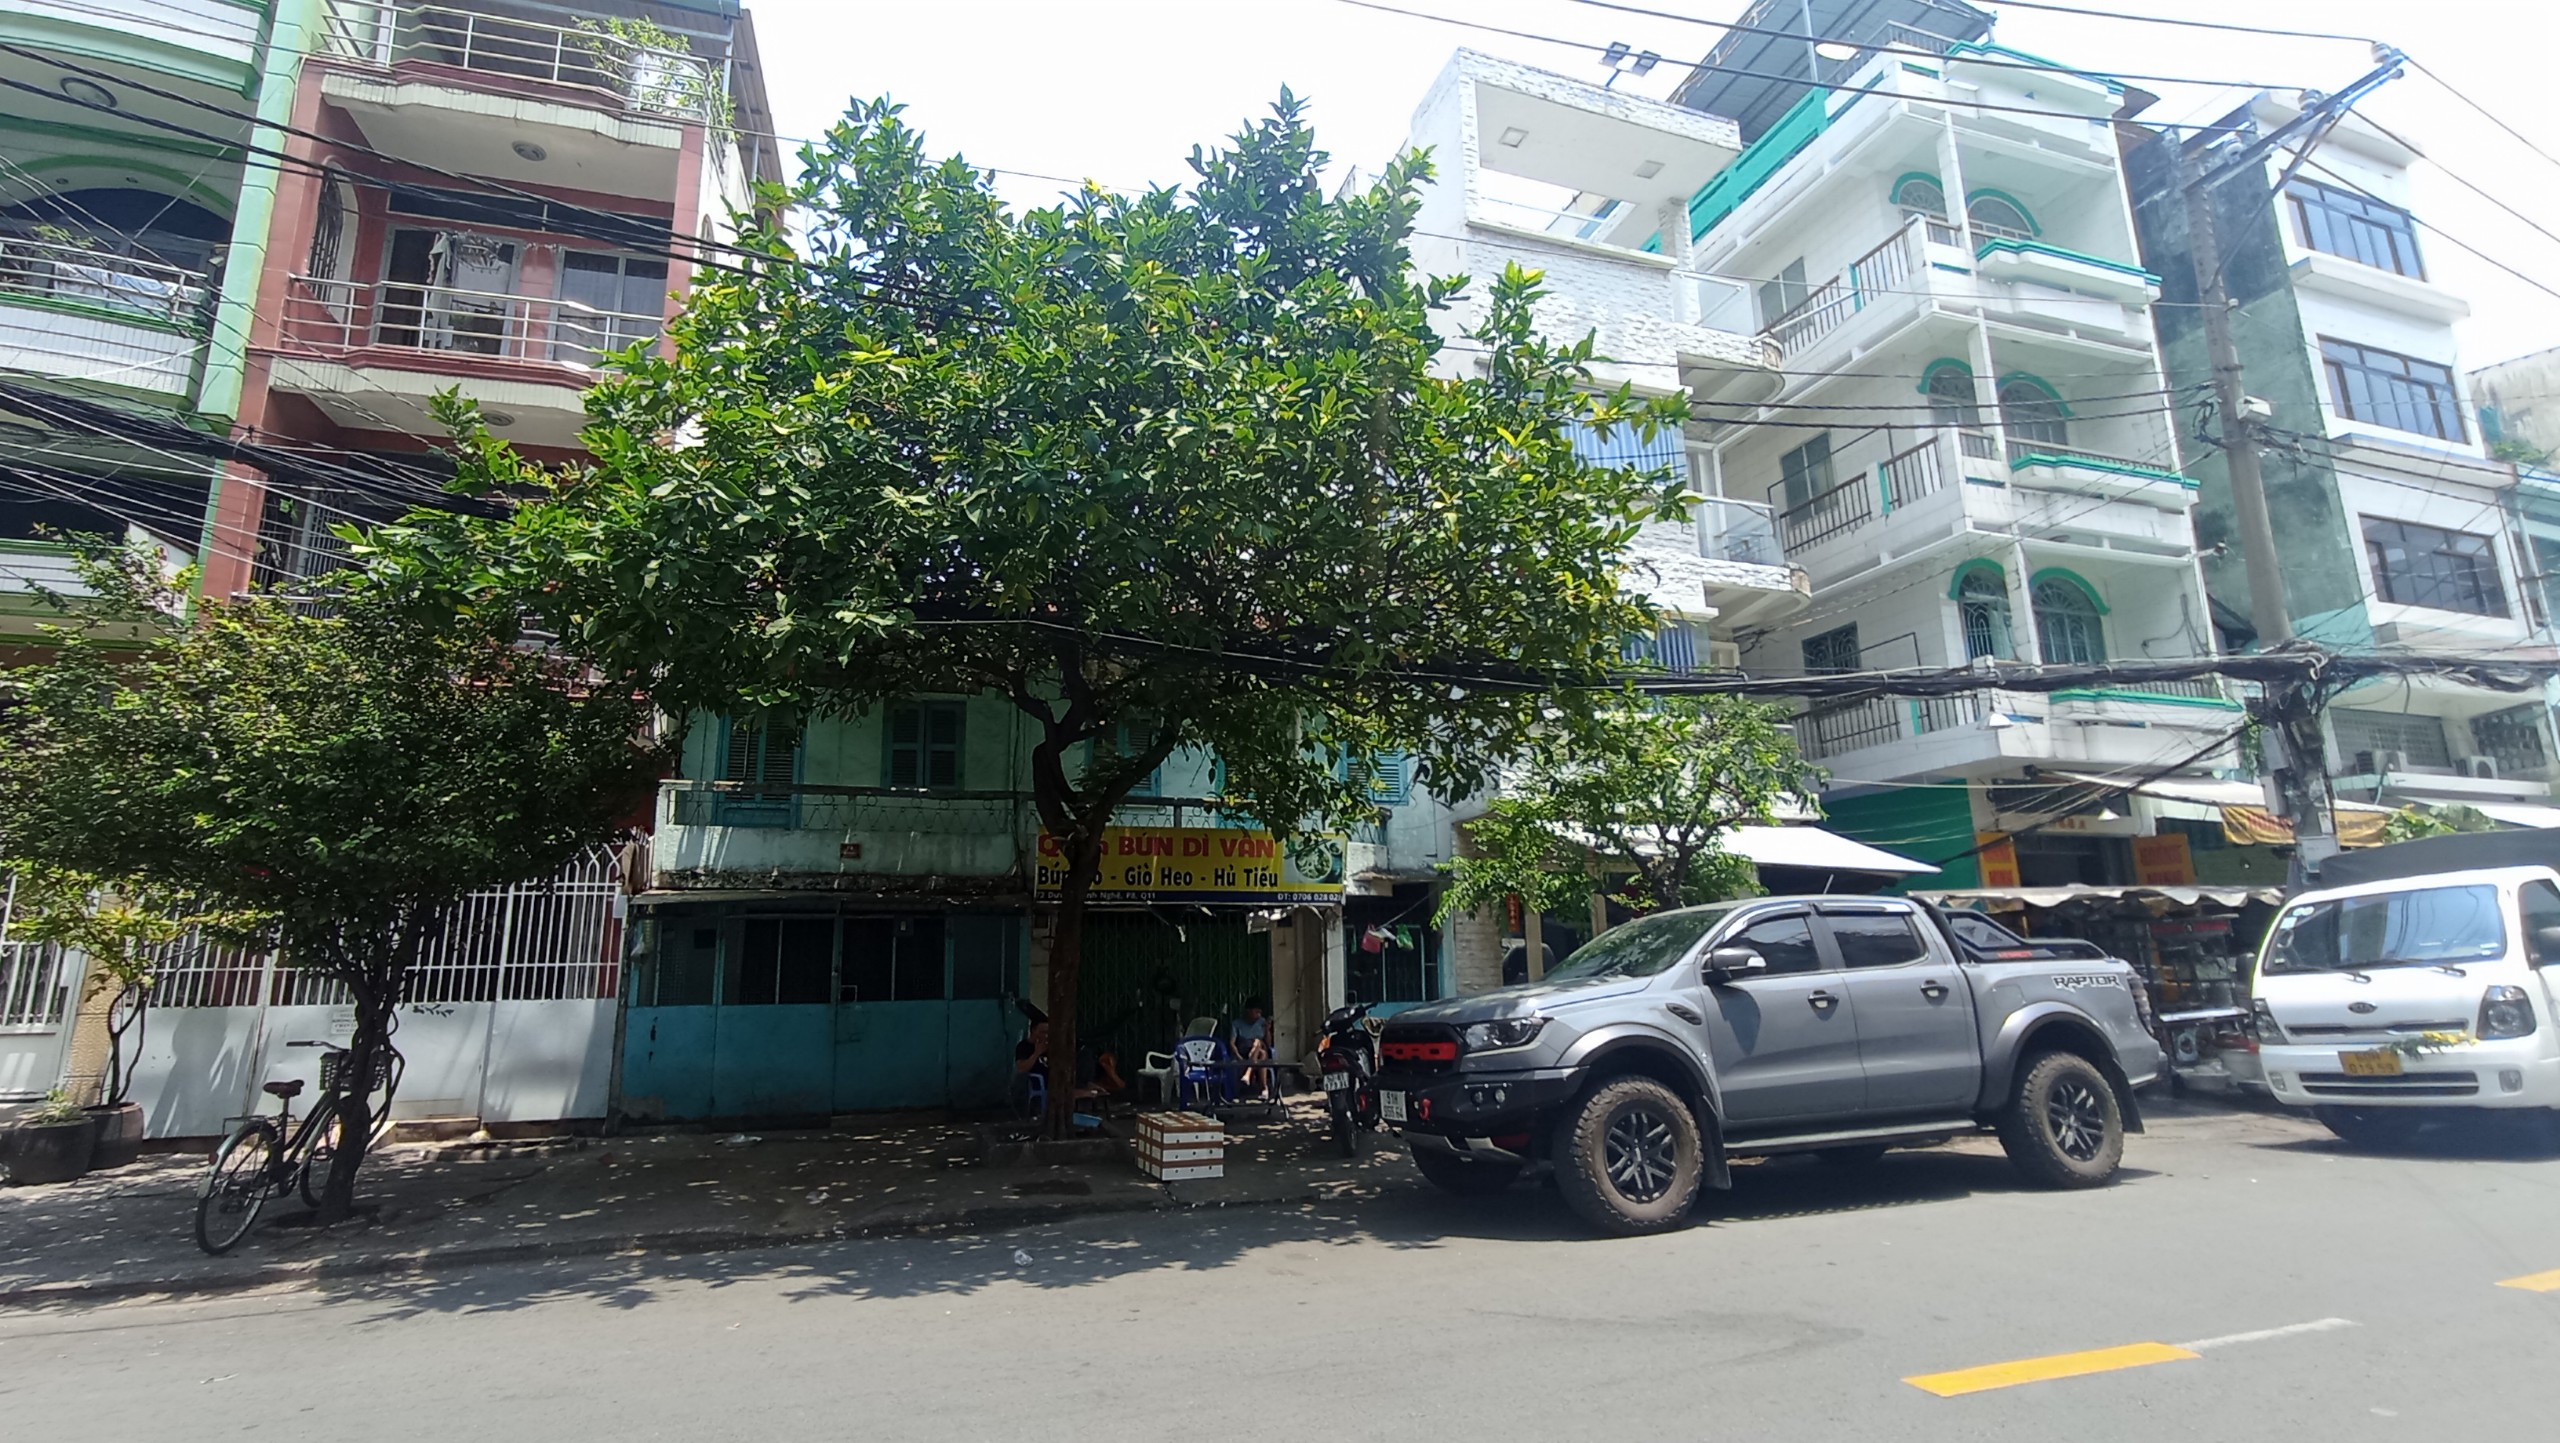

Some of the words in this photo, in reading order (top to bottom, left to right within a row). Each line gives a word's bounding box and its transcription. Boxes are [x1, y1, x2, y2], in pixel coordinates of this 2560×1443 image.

[1038, 833, 1109, 857] Qn
[1119, 832, 1173, 856] BÚN
[1183, 833, 1210, 857] DÌ
[1125, 862, 1153, 886] Giò
[1161, 867, 1193, 886] Heo
[1214, 864, 1236, 886] Hủ
[1243, 865, 1278, 887] Tiếu
[2051, 974, 2126, 993] RAPTOR
